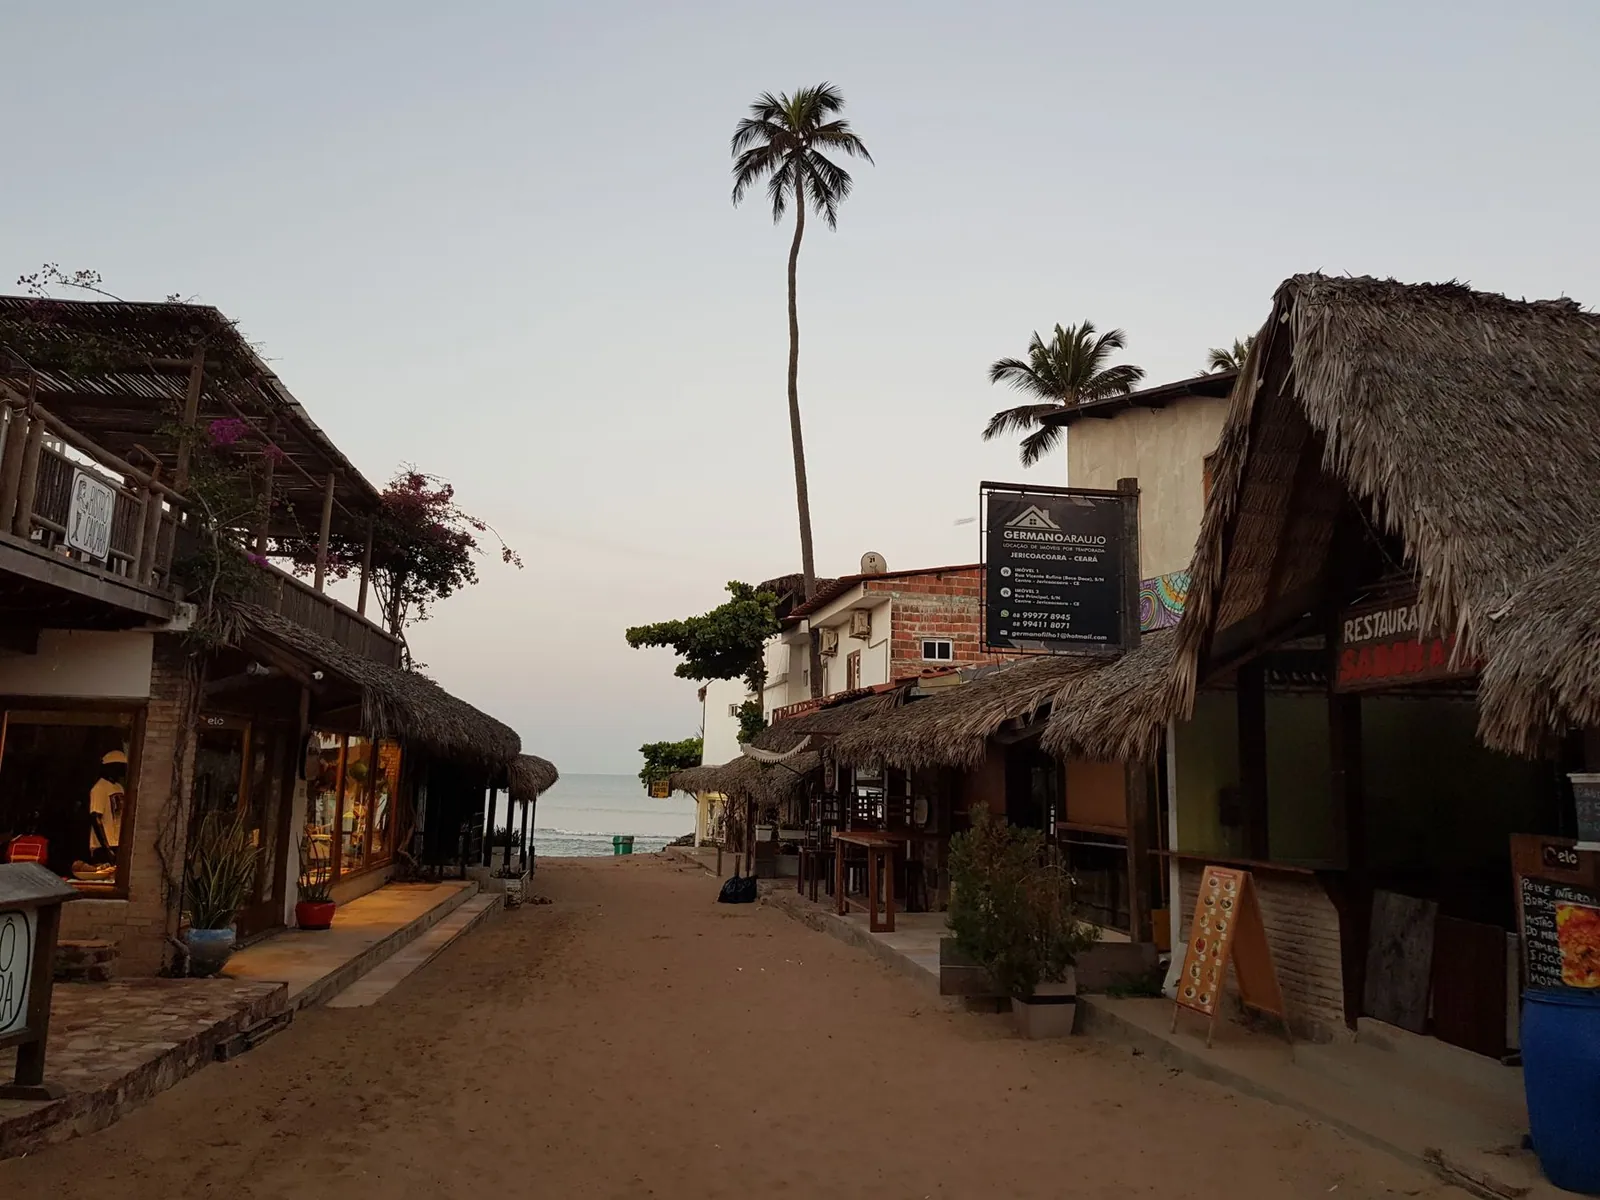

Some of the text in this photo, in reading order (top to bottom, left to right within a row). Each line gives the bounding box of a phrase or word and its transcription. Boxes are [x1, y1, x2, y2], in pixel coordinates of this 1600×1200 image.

[1003, 530, 1107, 545] GERMANOARAUJO
[1010, 552, 1067, 561] JERICOACOARA
[1073, 555, 1098, 563] CEARÁ
[1022, 611, 1049, 619] 99977
[1049, 613, 1071, 621] 8945
[1022, 620, 1047, 628] 99411
